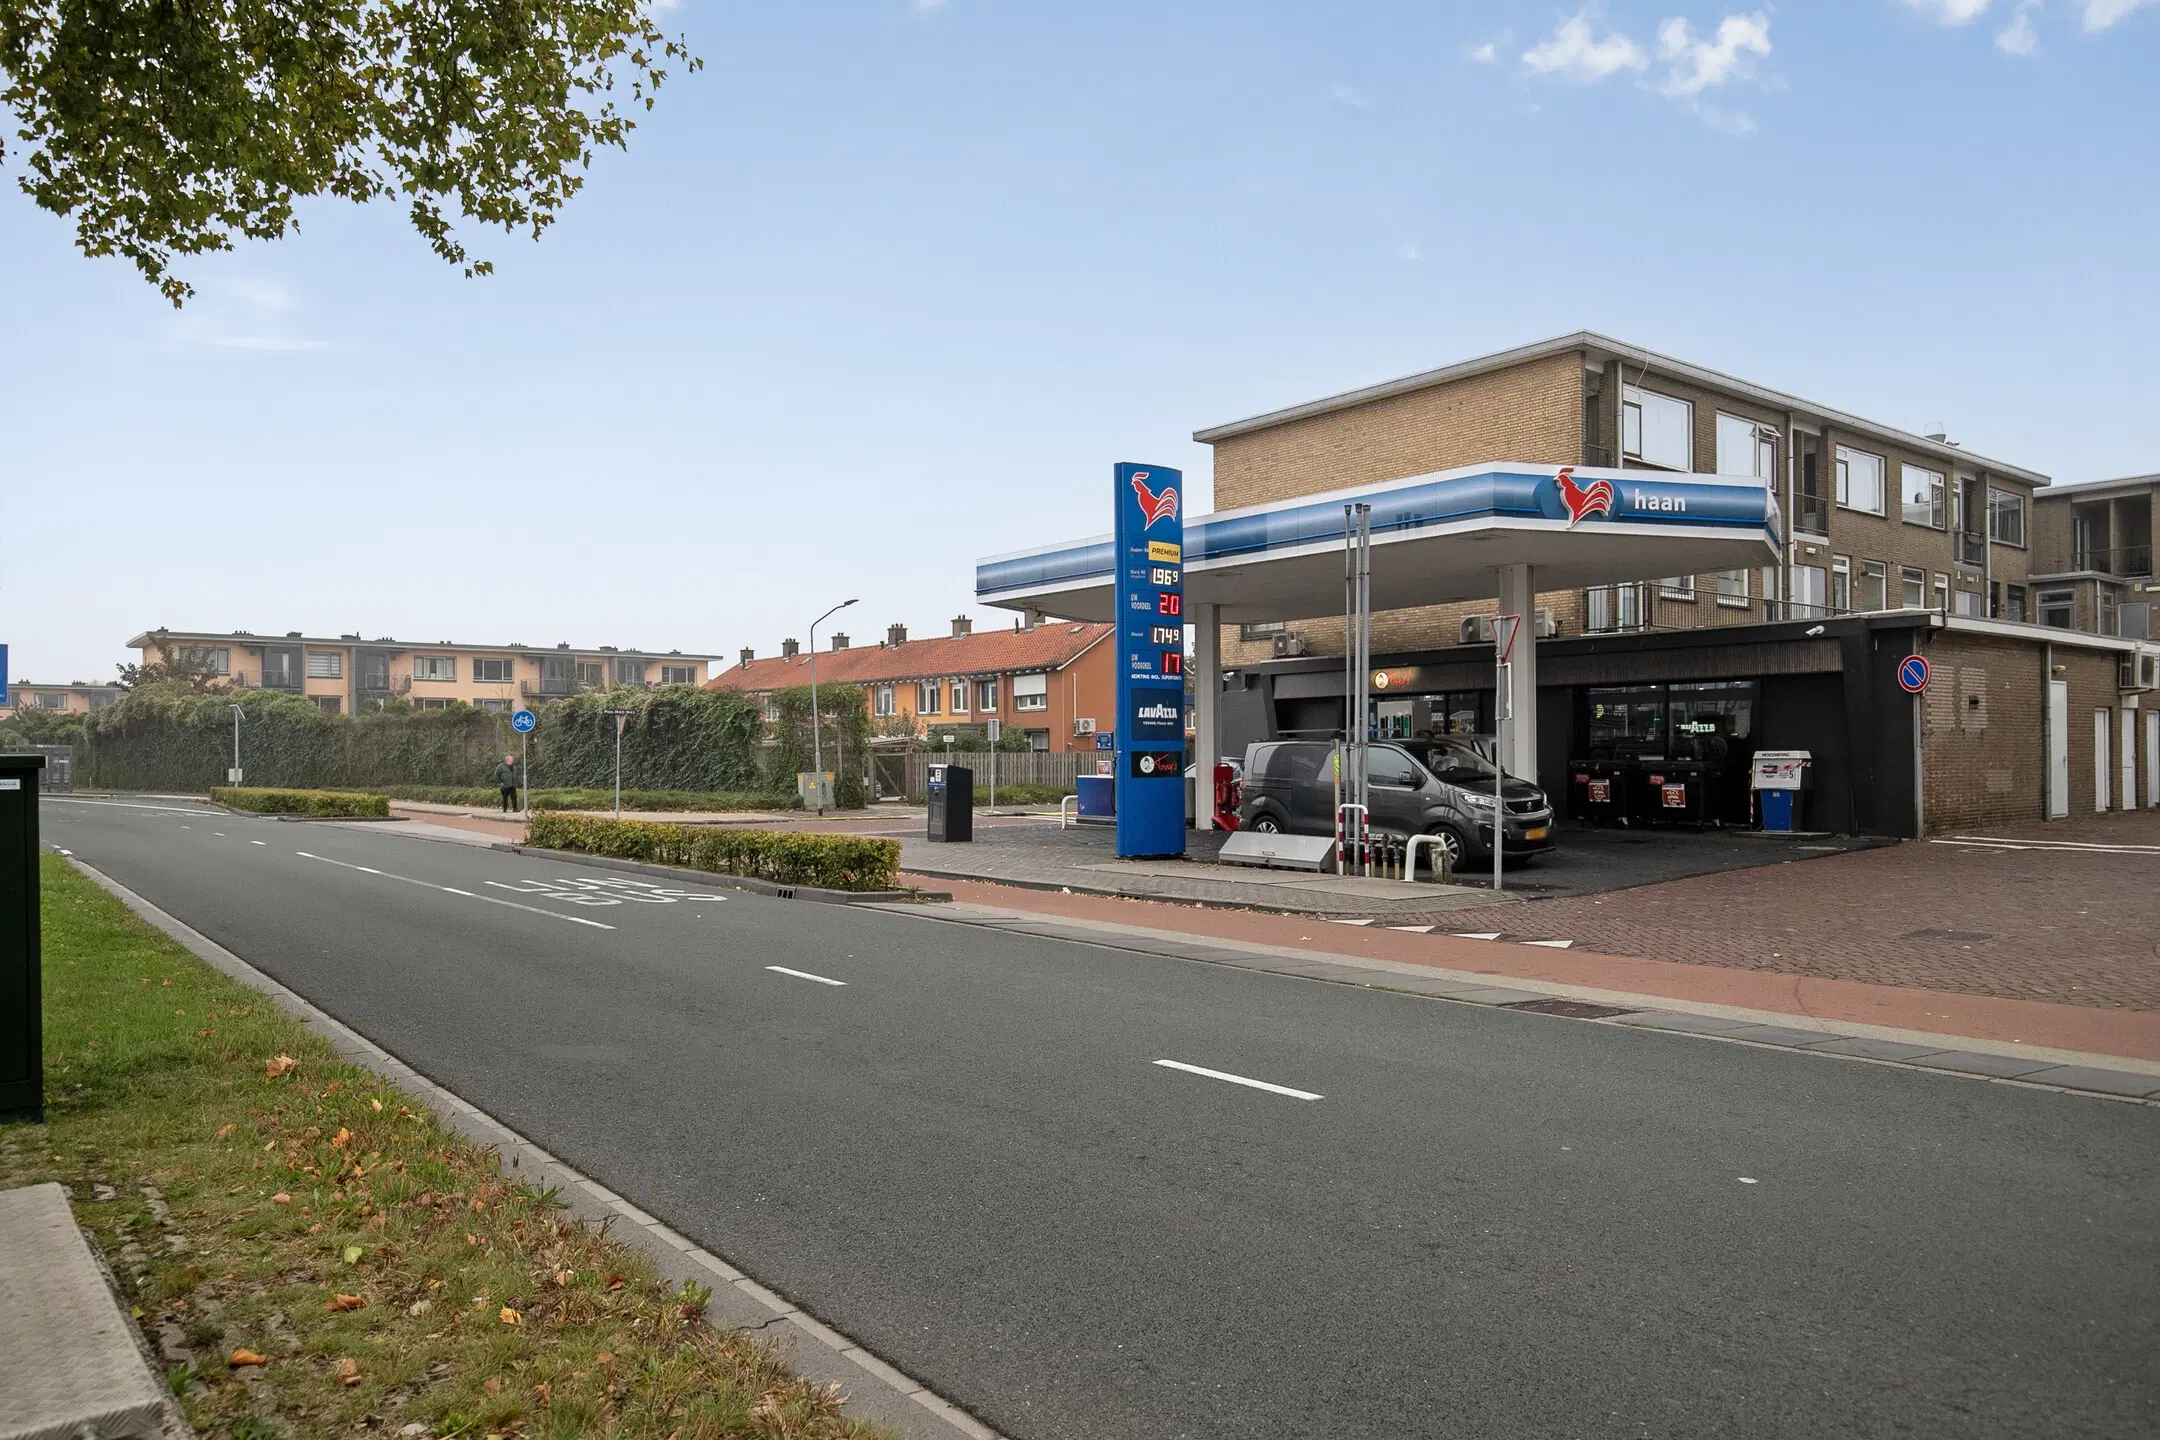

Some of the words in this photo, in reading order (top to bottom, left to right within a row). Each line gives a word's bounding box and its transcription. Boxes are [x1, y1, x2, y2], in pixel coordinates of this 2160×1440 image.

[1634, 488, 1686, 512] haan
[1151, 547, 1179, 557] PREMIUM
[1131, 602, 1152, 610] VOORDEEL
[1160, 594, 1180, 615] 20
[1131, 662, 1152, 670] VOORDEEL
[1165, 653, 1180, 673] 17
[1138, 703, 1178, 719] LAVAZZA
[540, 889, 728, 906] BUS
